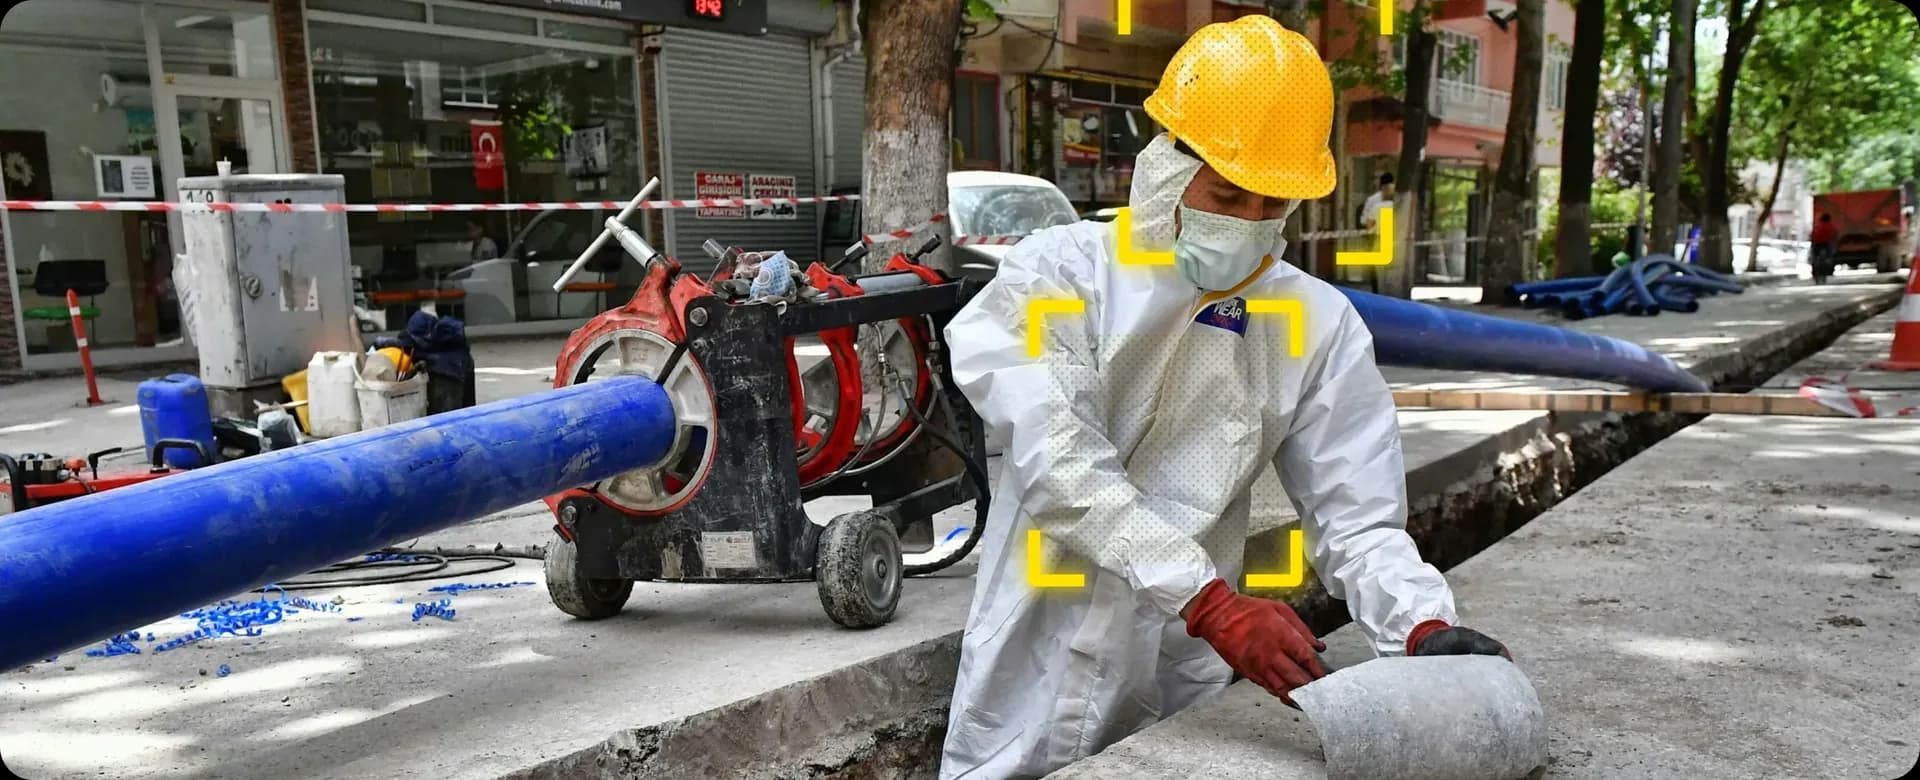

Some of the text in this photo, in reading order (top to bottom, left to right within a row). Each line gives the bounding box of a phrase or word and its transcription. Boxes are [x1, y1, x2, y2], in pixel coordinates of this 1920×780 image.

[704, 174, 736, 184] GARAJ
[752, 176, 794, 188] ARACINIZ
[1213, 301, 1243, 320] WEAR
